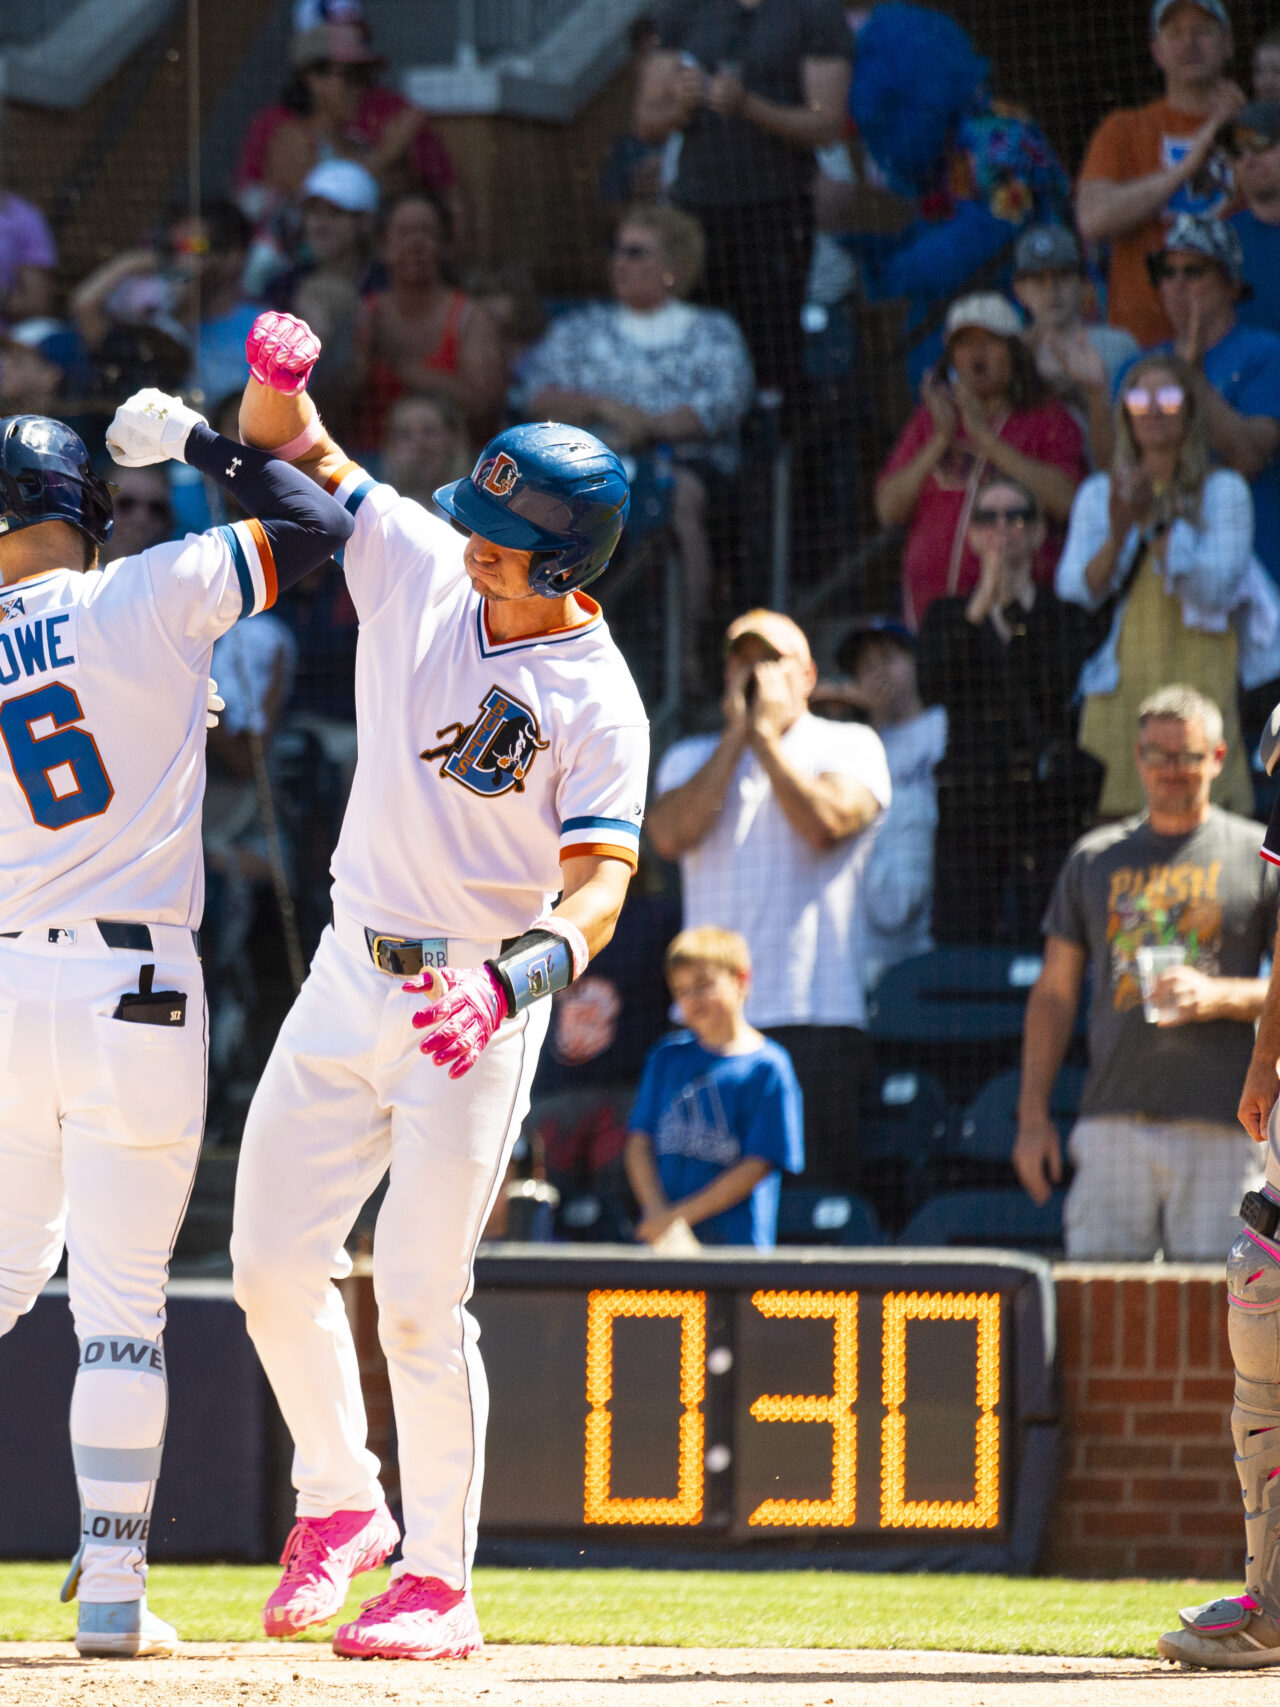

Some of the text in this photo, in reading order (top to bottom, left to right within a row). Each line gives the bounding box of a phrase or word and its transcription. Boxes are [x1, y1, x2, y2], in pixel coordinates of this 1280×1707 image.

[455, 699, 509, 786] BULLS
[424, 951, 447, 969] RB
[79, 1341, 163, 1371] OWE
